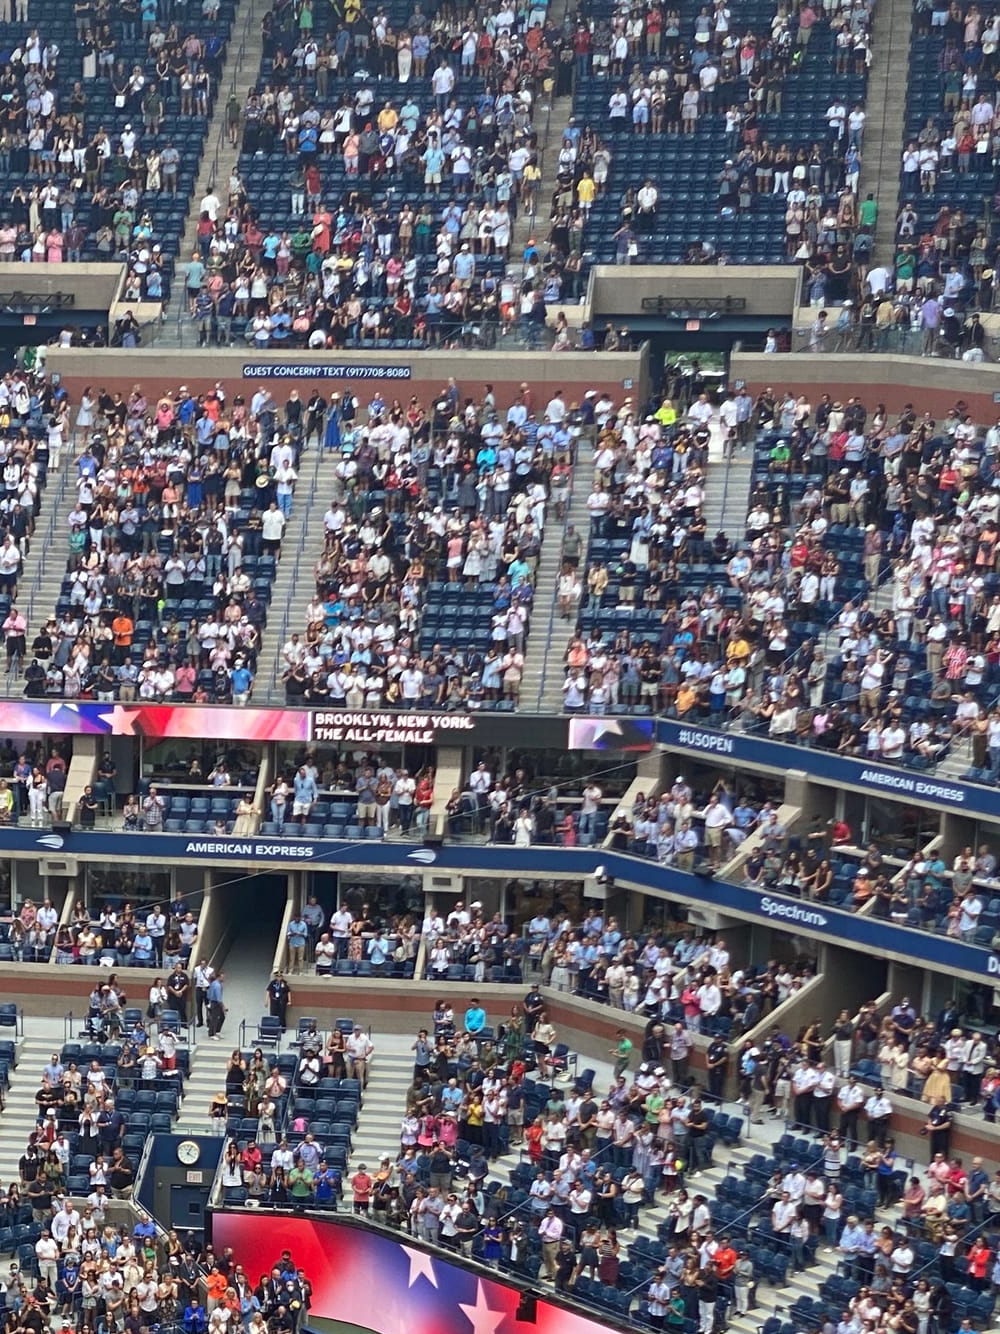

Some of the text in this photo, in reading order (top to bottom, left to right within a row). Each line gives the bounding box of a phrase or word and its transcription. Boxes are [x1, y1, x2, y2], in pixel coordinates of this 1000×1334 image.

[243, 366, 410, 377] GUEST CONCERN? TEXT (917)708-8080
[315, 712, 394, 728] BROOKLYN,
[396, 714, 428, 728] NEW
[315, 728, 433, 743] THE ALL-FEMALE
[679, 729, 733, 752] #USOPEN
[860, 770, 965, 802] AMERICAN EXPRESS
[186, 842, 314, 857] AMERICAN EXPRESS
[760, 897, 826, 926] Spectrum
